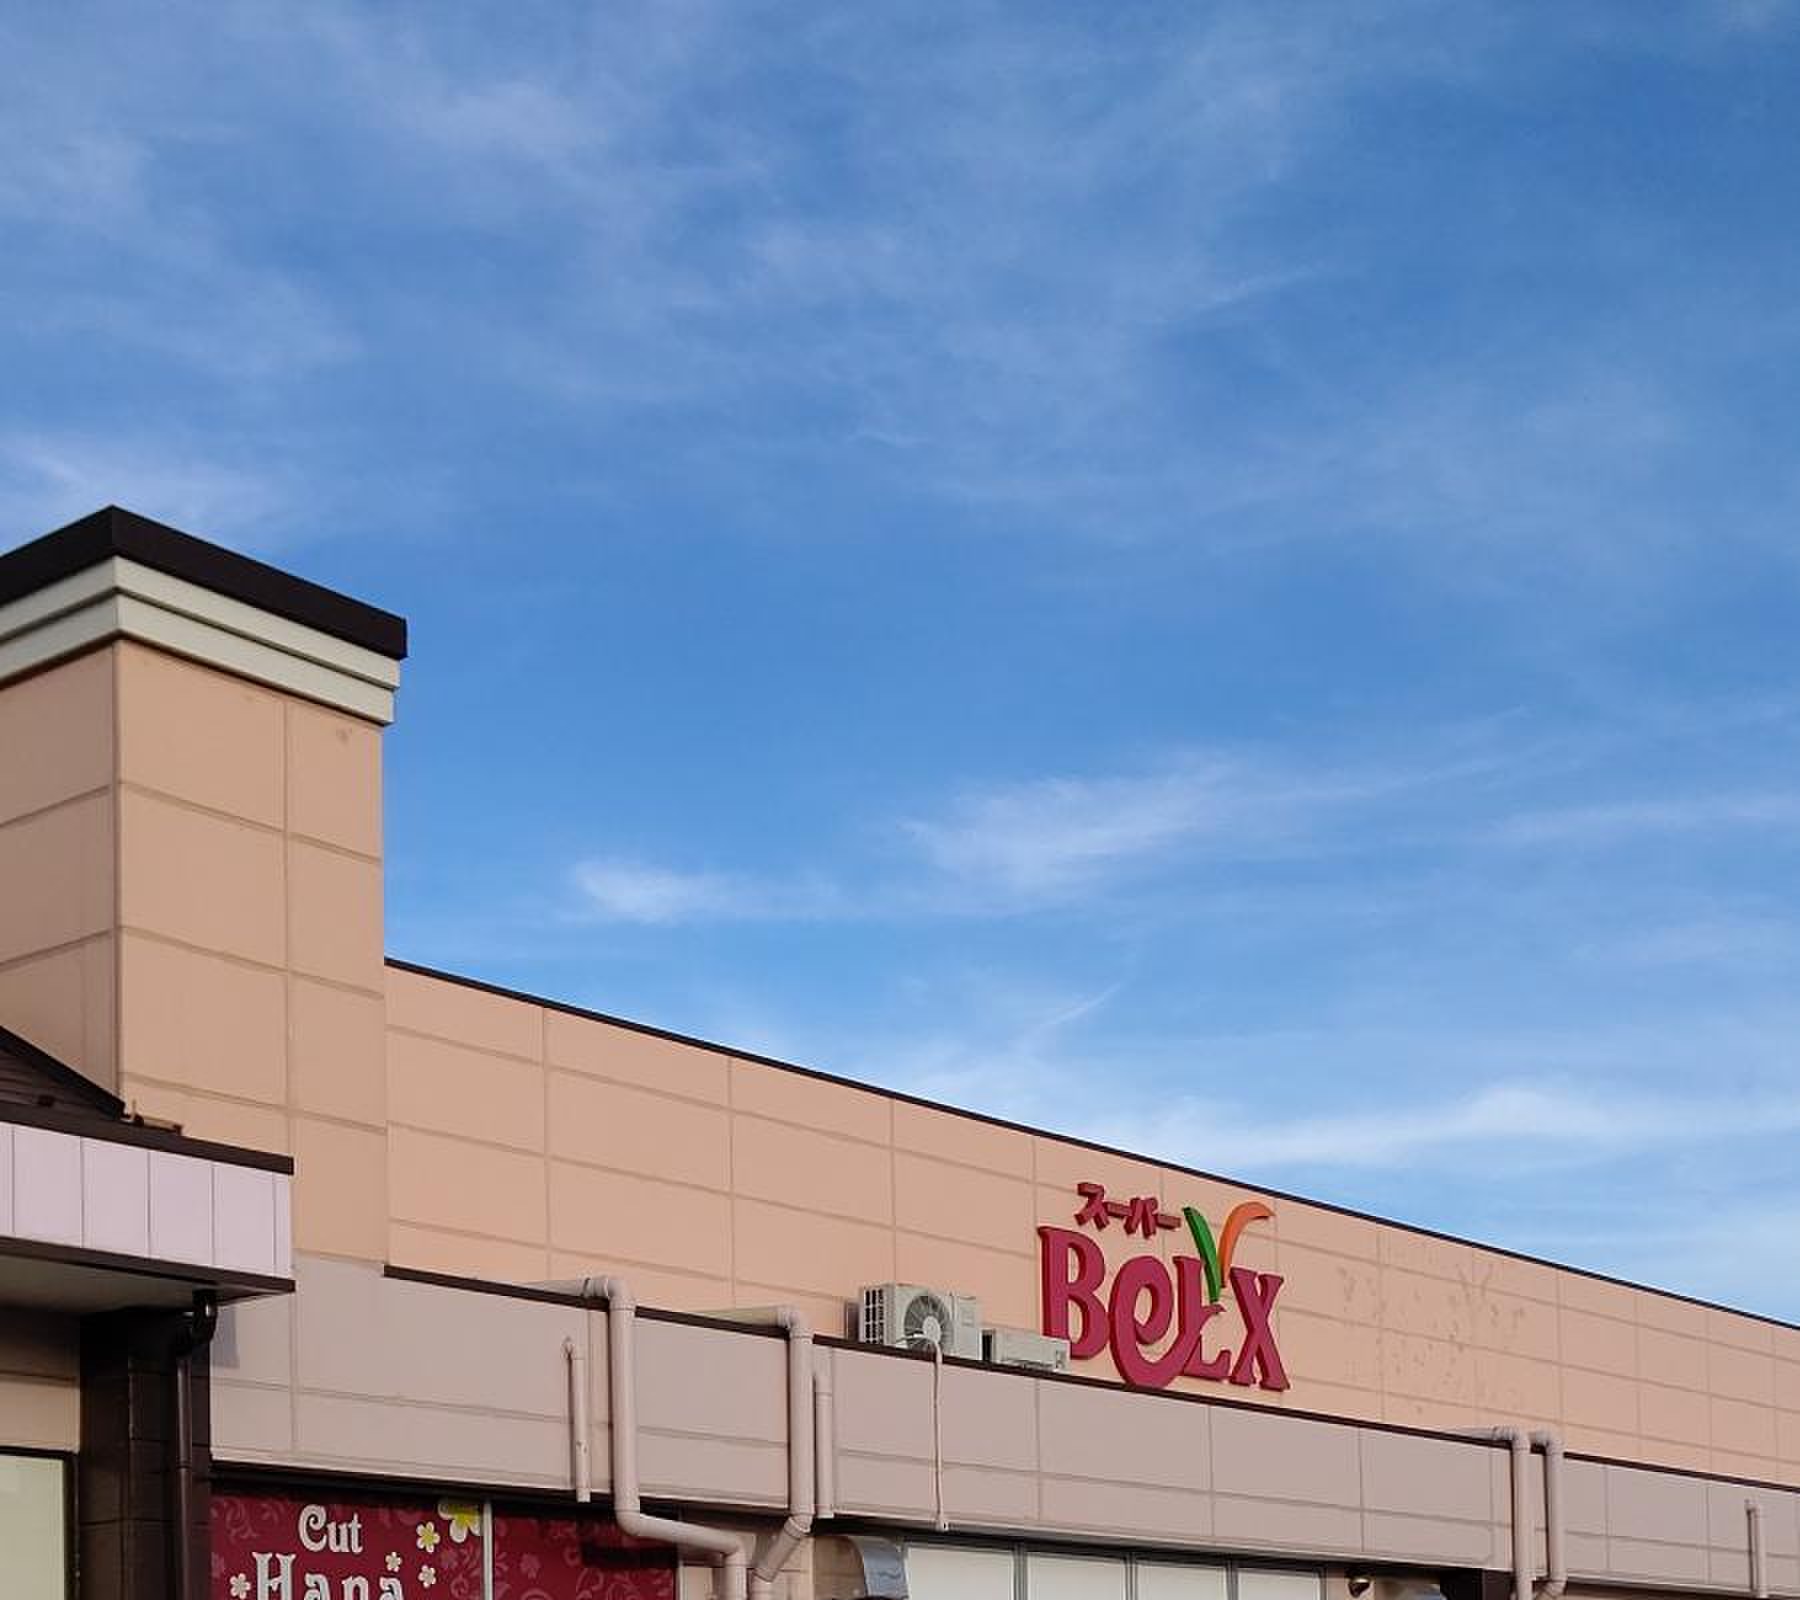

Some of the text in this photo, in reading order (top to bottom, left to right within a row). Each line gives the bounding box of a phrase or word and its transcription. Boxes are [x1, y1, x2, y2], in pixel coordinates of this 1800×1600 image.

[1074, 1182, 1181, 1239] スーパー
[298, 1504, 363, 1553] Cut
